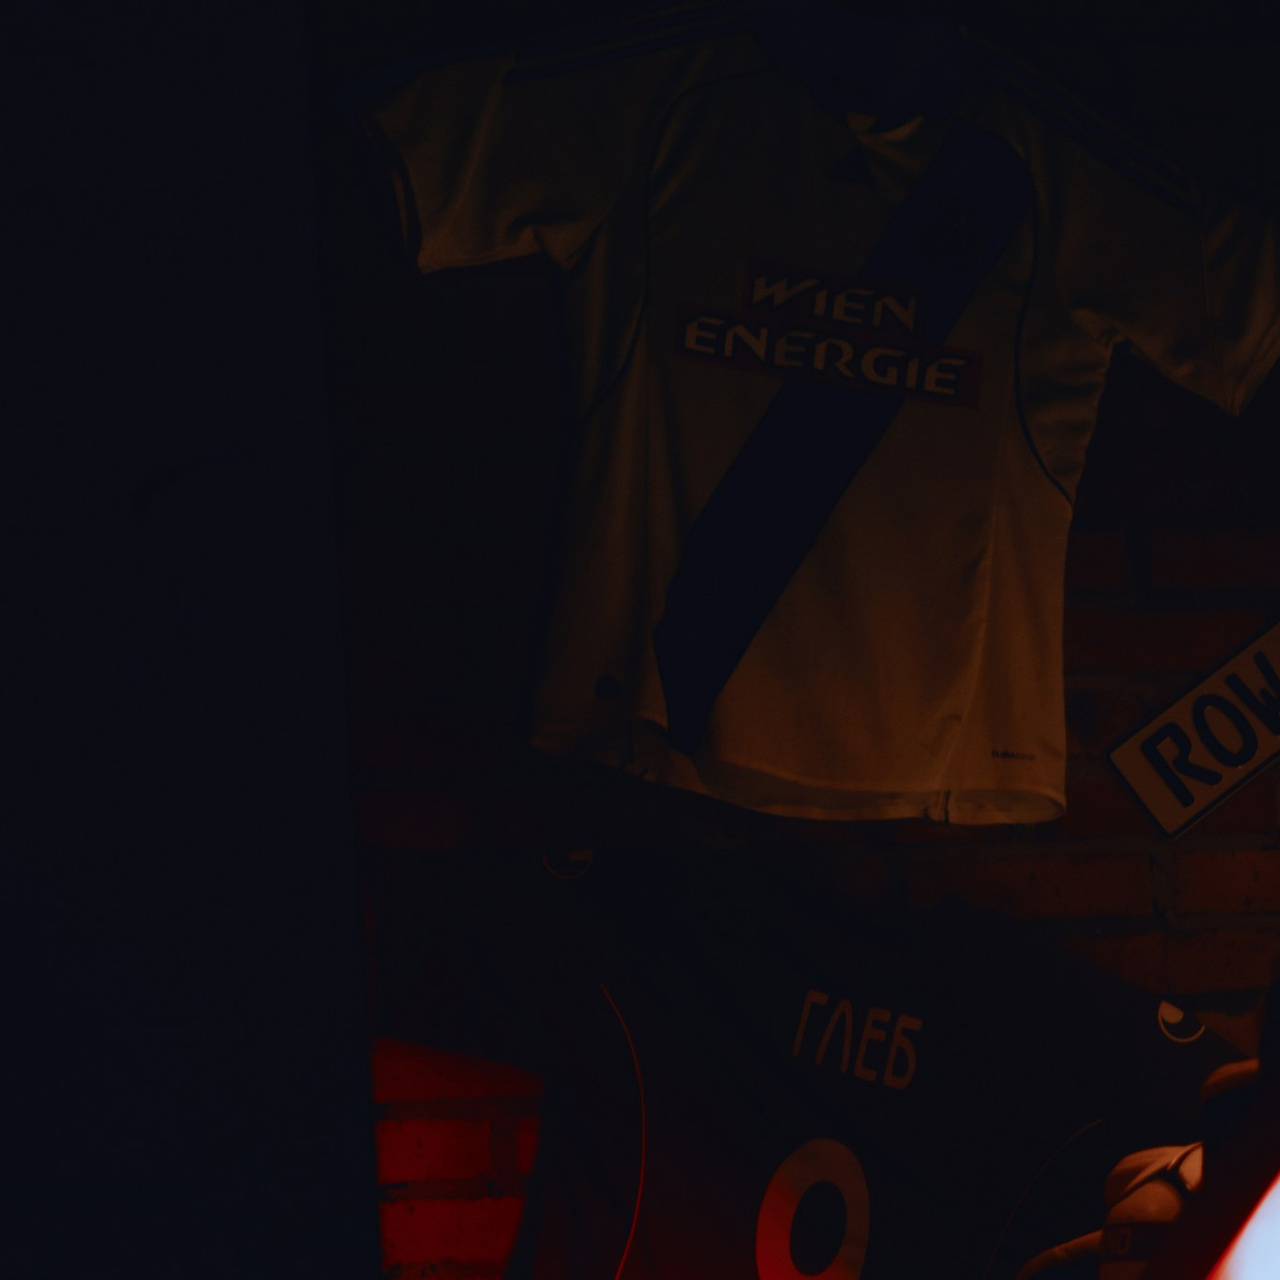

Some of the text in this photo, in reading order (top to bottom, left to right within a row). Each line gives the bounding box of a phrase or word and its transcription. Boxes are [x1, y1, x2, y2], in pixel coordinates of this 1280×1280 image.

[750, 268, 920, 334] WIEN
[683, 316, 971, 400] ENERGIE
[791, 988, 923, 1091] ГЛЕБ
